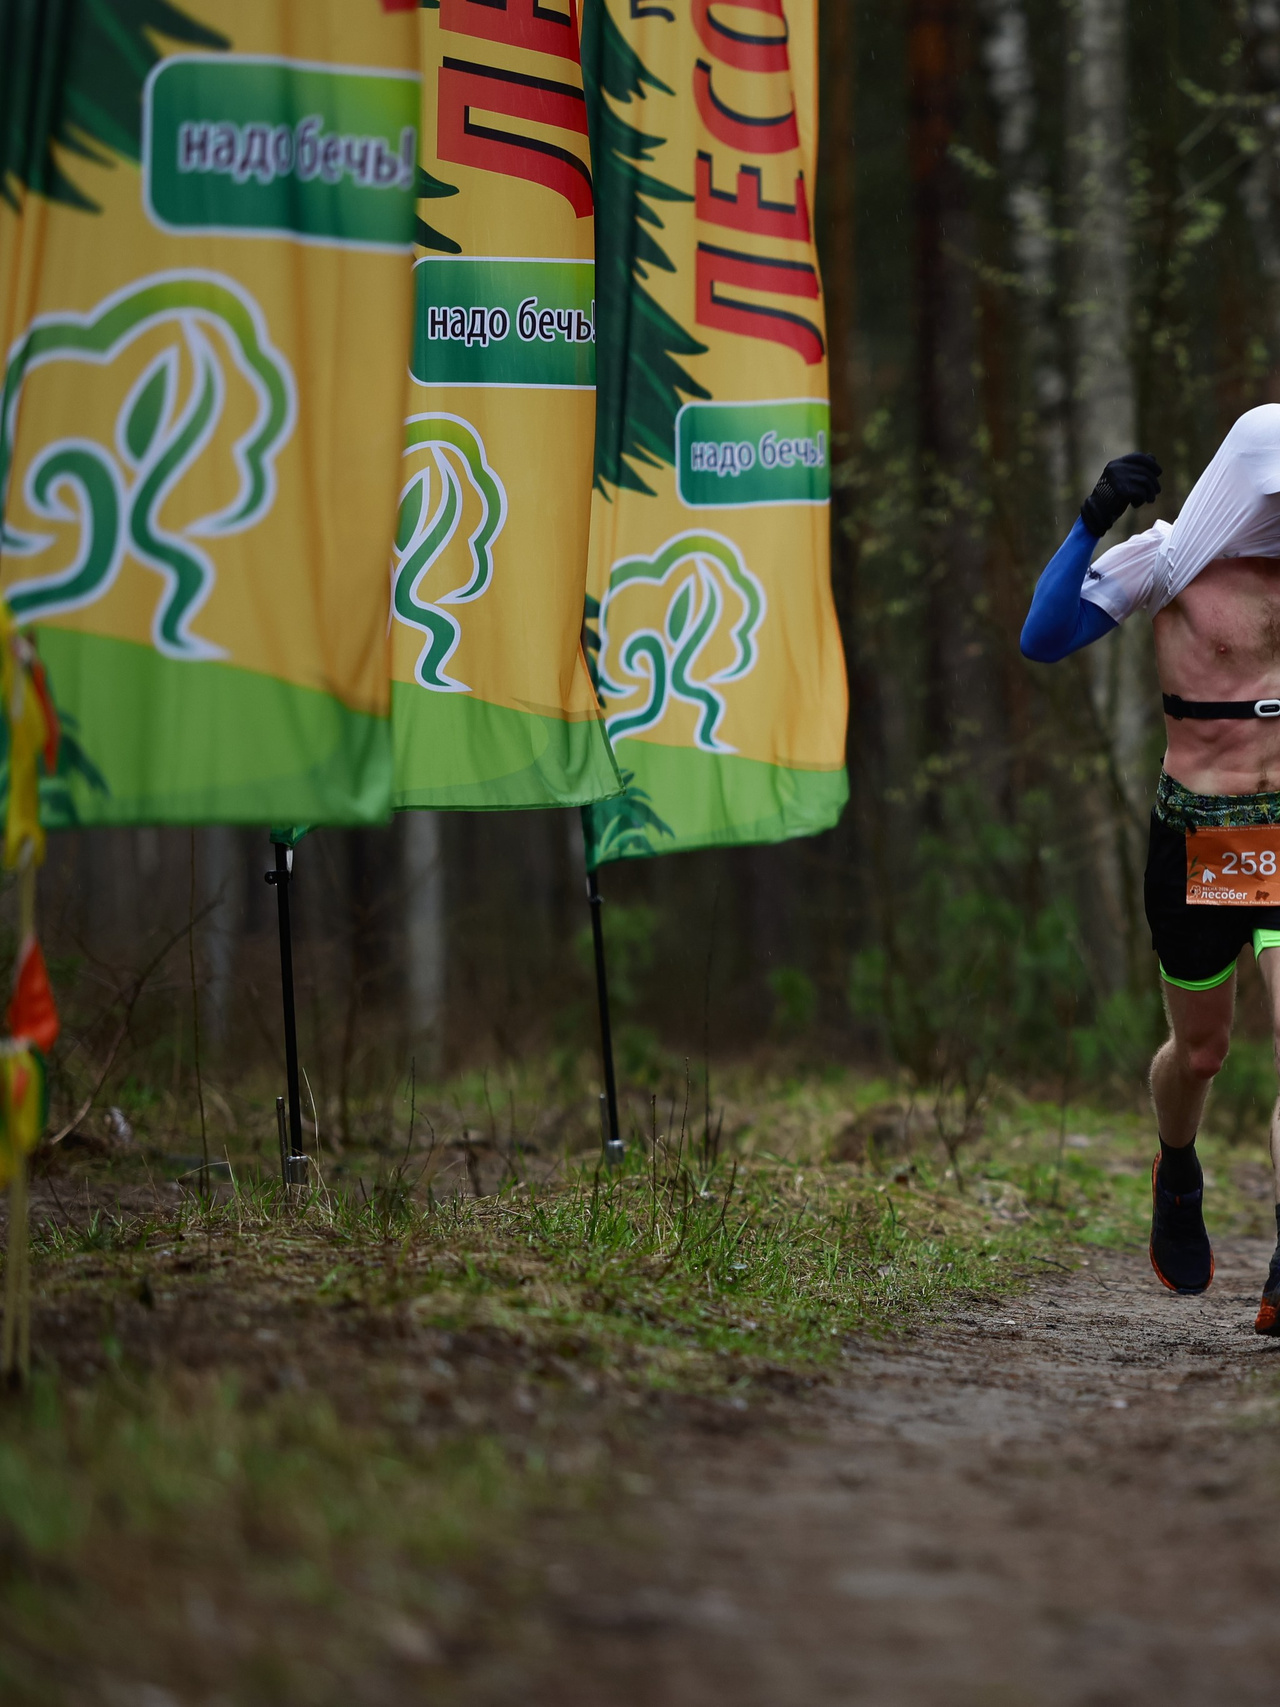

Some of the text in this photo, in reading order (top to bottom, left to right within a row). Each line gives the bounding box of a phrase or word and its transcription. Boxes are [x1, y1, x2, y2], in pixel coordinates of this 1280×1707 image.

[428, 306, 510, 347] надо
[691, 430, 826, 477] надо бечь!
[1221, 850, 1277, 876] 258
[1201, 889, 1248, 900] лесобег
